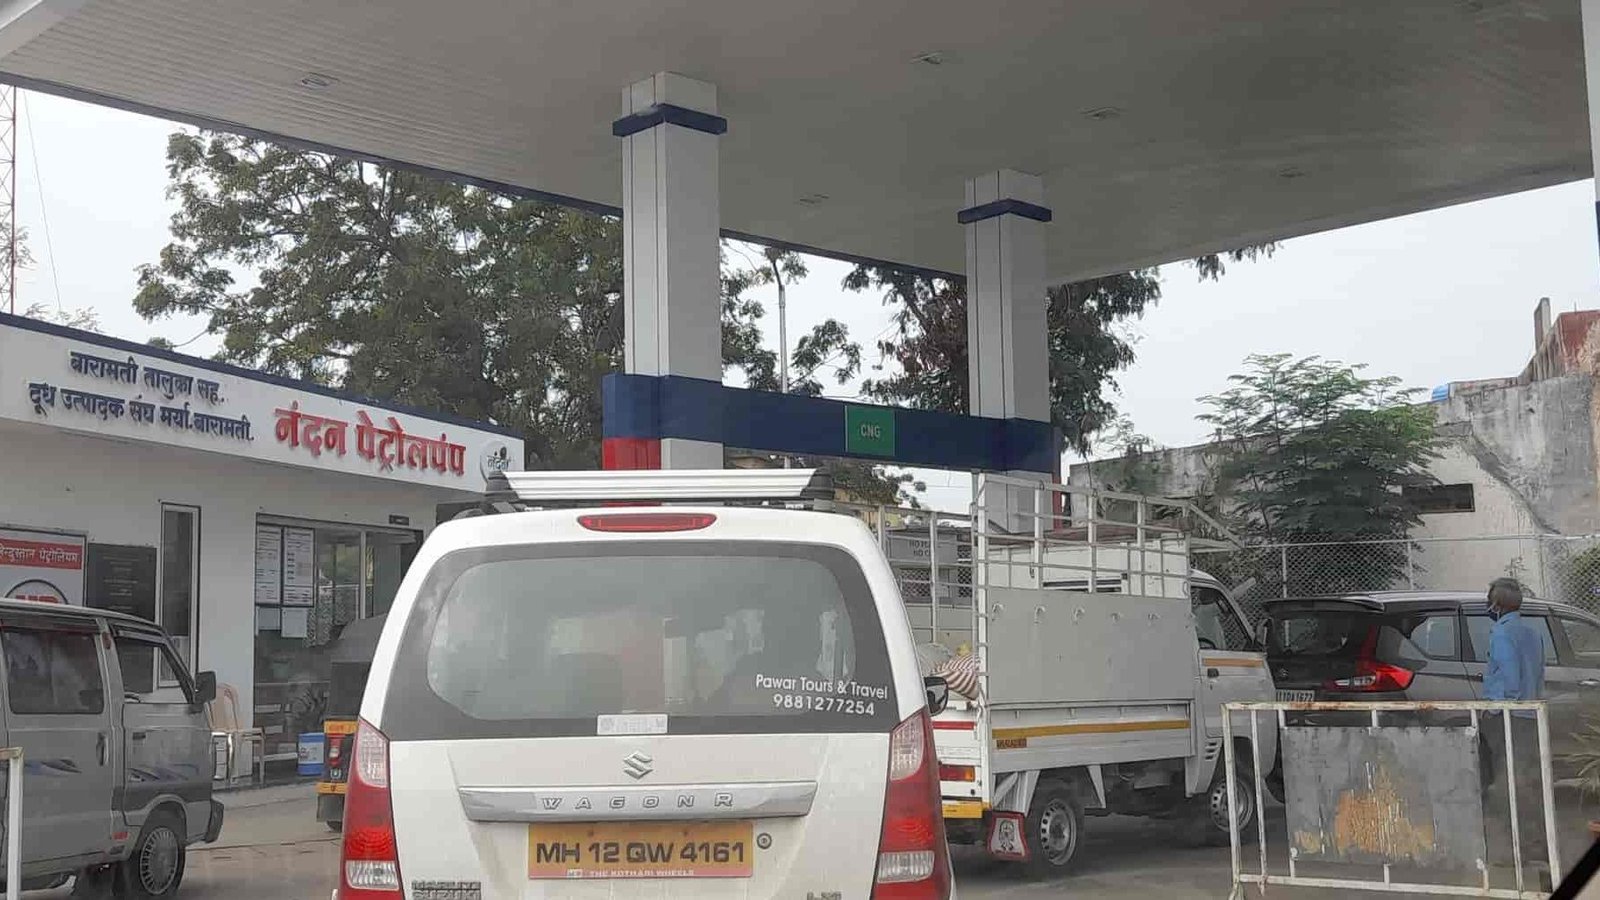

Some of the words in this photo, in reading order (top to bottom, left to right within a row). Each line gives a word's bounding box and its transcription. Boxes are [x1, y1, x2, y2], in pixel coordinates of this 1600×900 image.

[69, 351, 139, 385] बारामती
[143, 366, 194, 399] तालुका
[29, 382, 57, 416] दूध
[60, 388, 126, 421] उत्पादक
[129, 394, 156, 424] संघ
[275, 401, 348, 457] नंदन
[356, 410, 467, 477] पेट्रोलपंप
[860, 423, 881, 439] CNG
[756, 674, 796, 691] Pawar
[800, 677, 833, 692] Tours
[837, 680, 848, 694] &
[851, 681, 888, 699] Travel
[773, 693, 875, 716] 9881277254
[536, 842, 581, 864] MH
[588, 842, 620, 863] 12
[626, 842, 675, 863] QW
[680, 841, 744, 863] 4161
